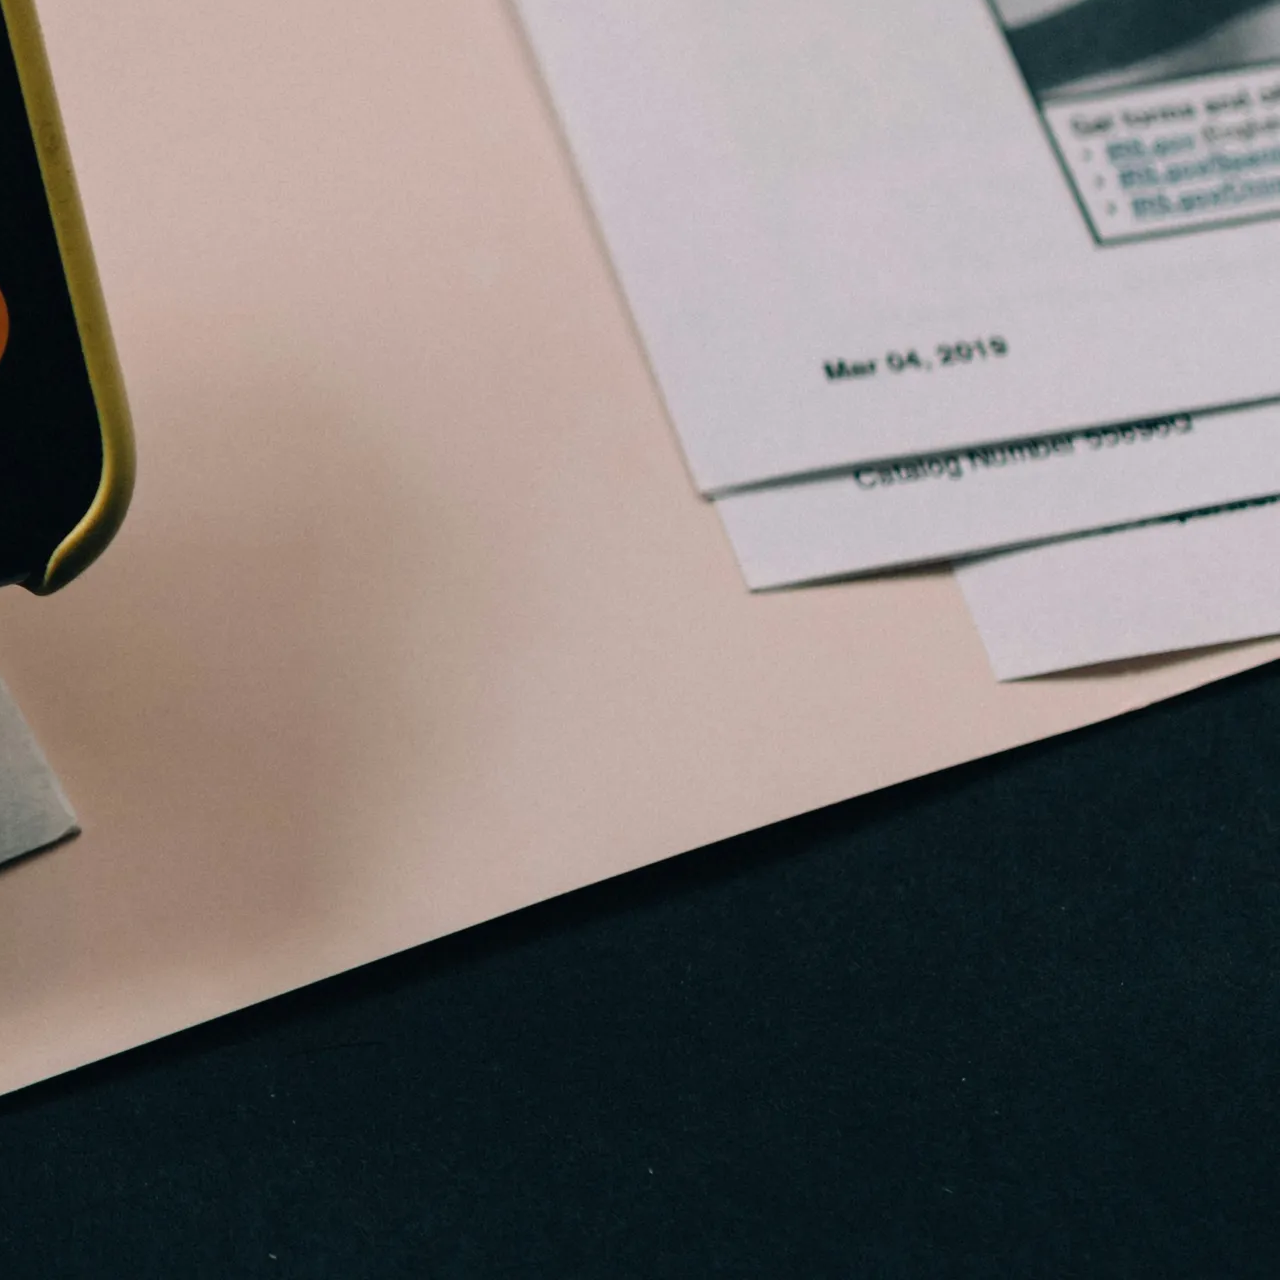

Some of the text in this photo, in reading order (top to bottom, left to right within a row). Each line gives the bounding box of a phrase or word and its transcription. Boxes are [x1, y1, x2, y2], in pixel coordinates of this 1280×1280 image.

[824, 335, 1009, 382] Mar 04, 2019
